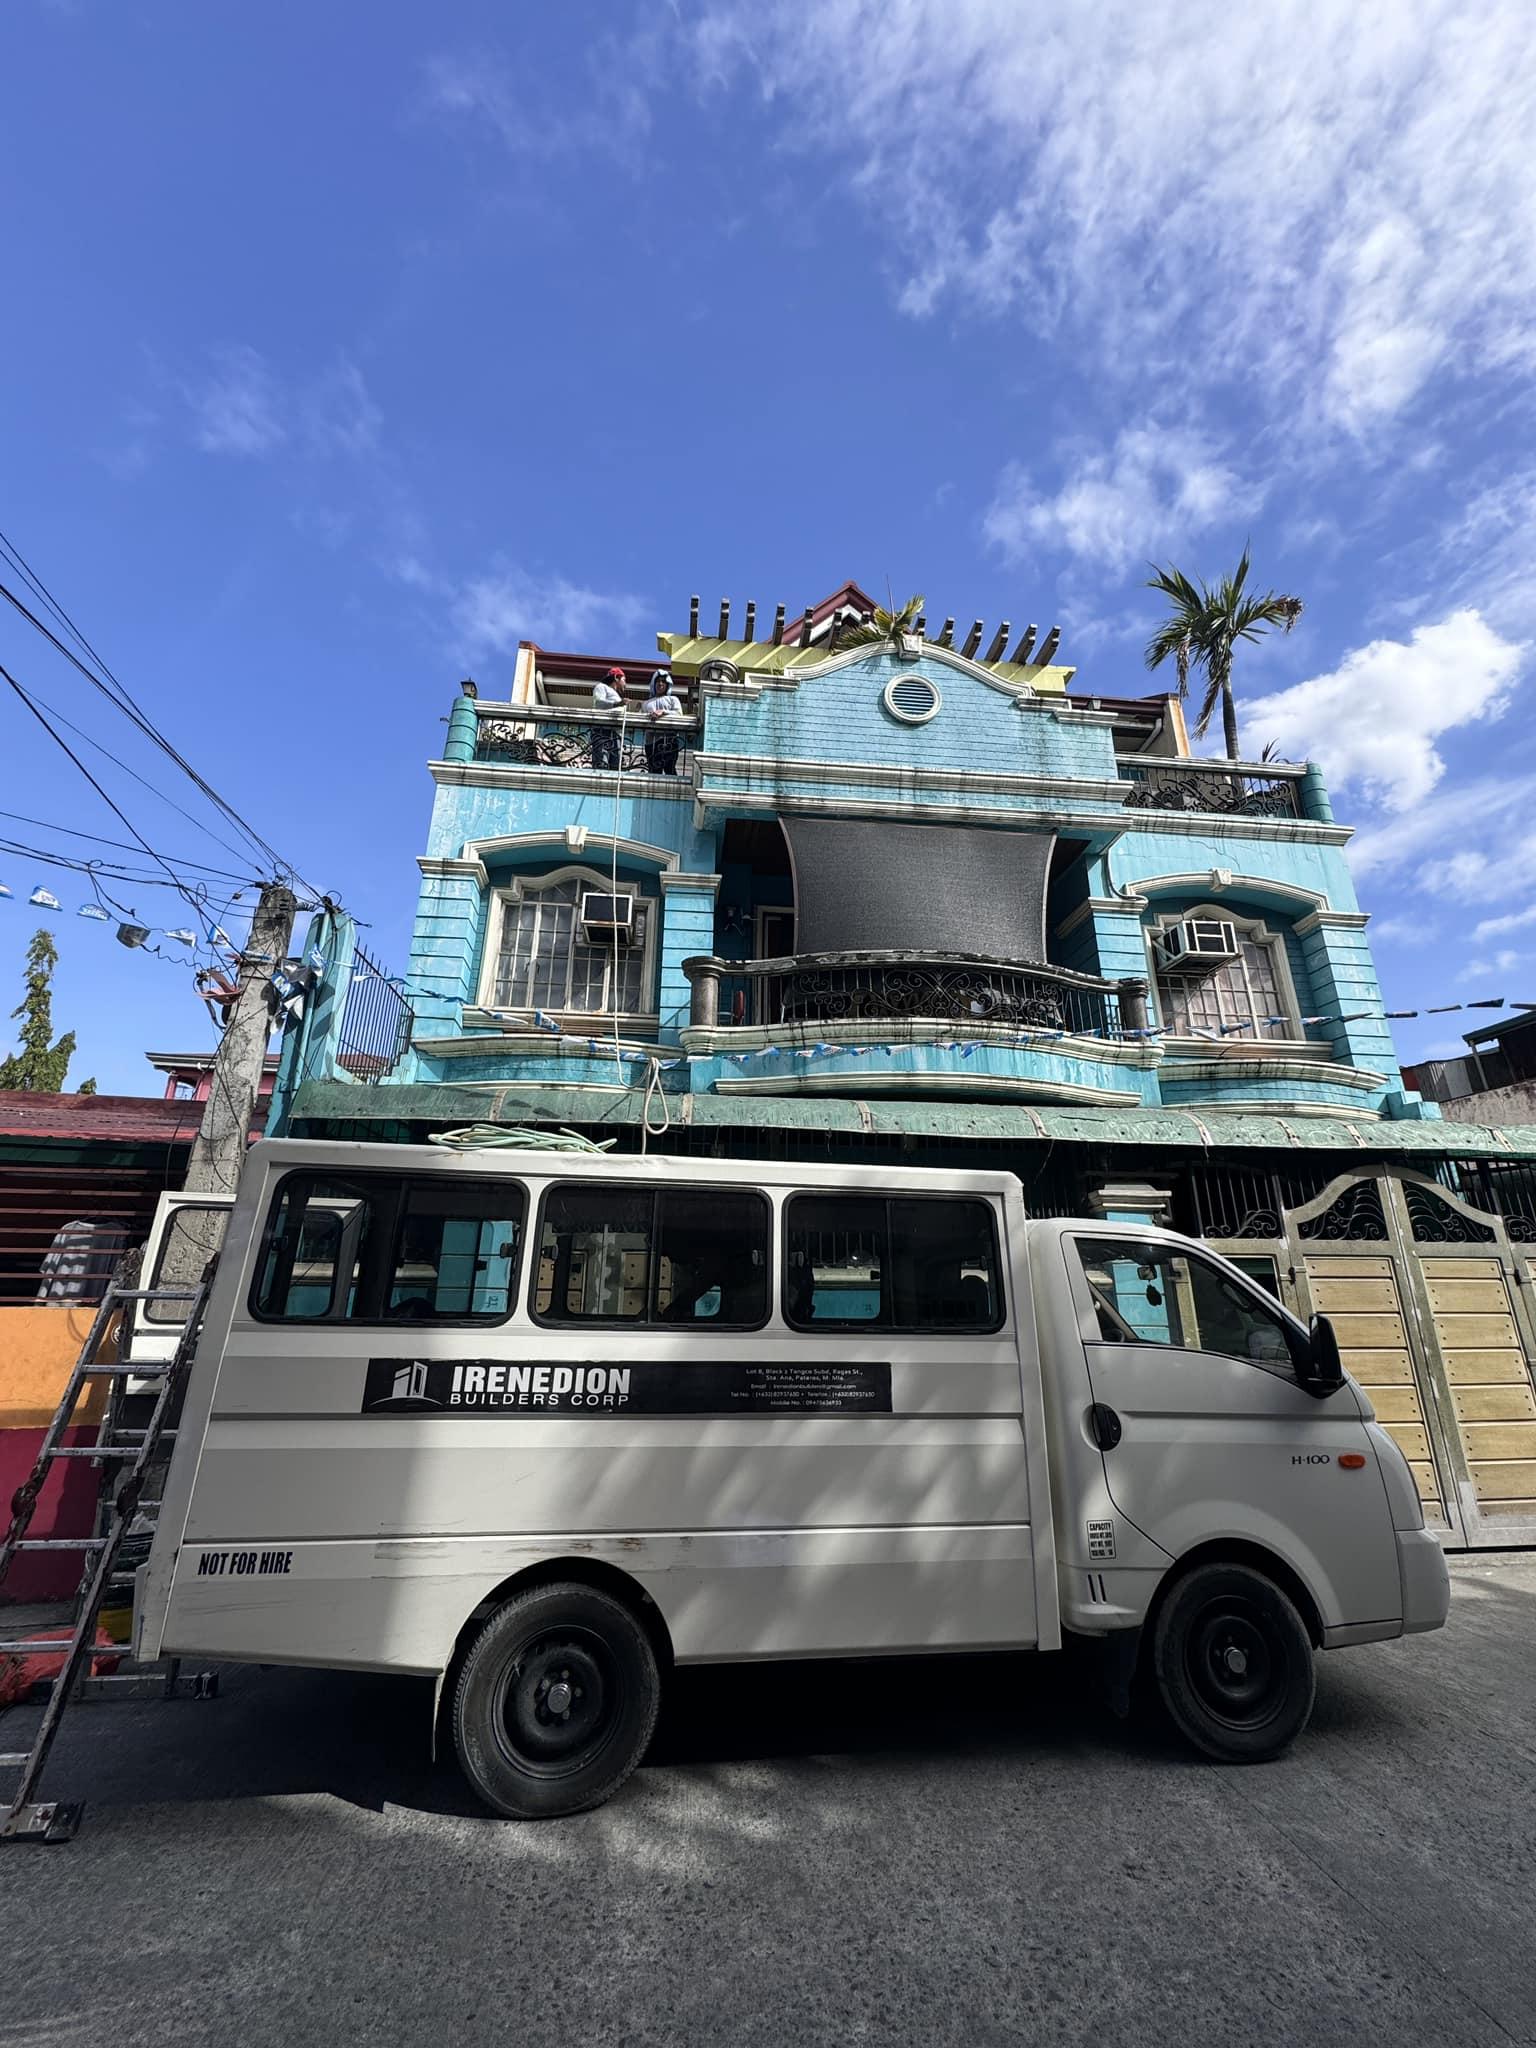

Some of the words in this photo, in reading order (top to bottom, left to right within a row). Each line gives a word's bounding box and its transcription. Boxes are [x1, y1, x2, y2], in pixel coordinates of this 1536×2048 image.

[451, 1366, 631, 1394] IRENEDION
[450, 1393, 559, 1405] BUILDERS
[571, 1394, 629, 1406] CORP
[1089, 1523, 1111, 1531] CAPACITY
[197, 1552, 230, 1576] NOT
[229, 1551, 258, 1575] FOR
[258, 1551, 293, 1574] HIRE
